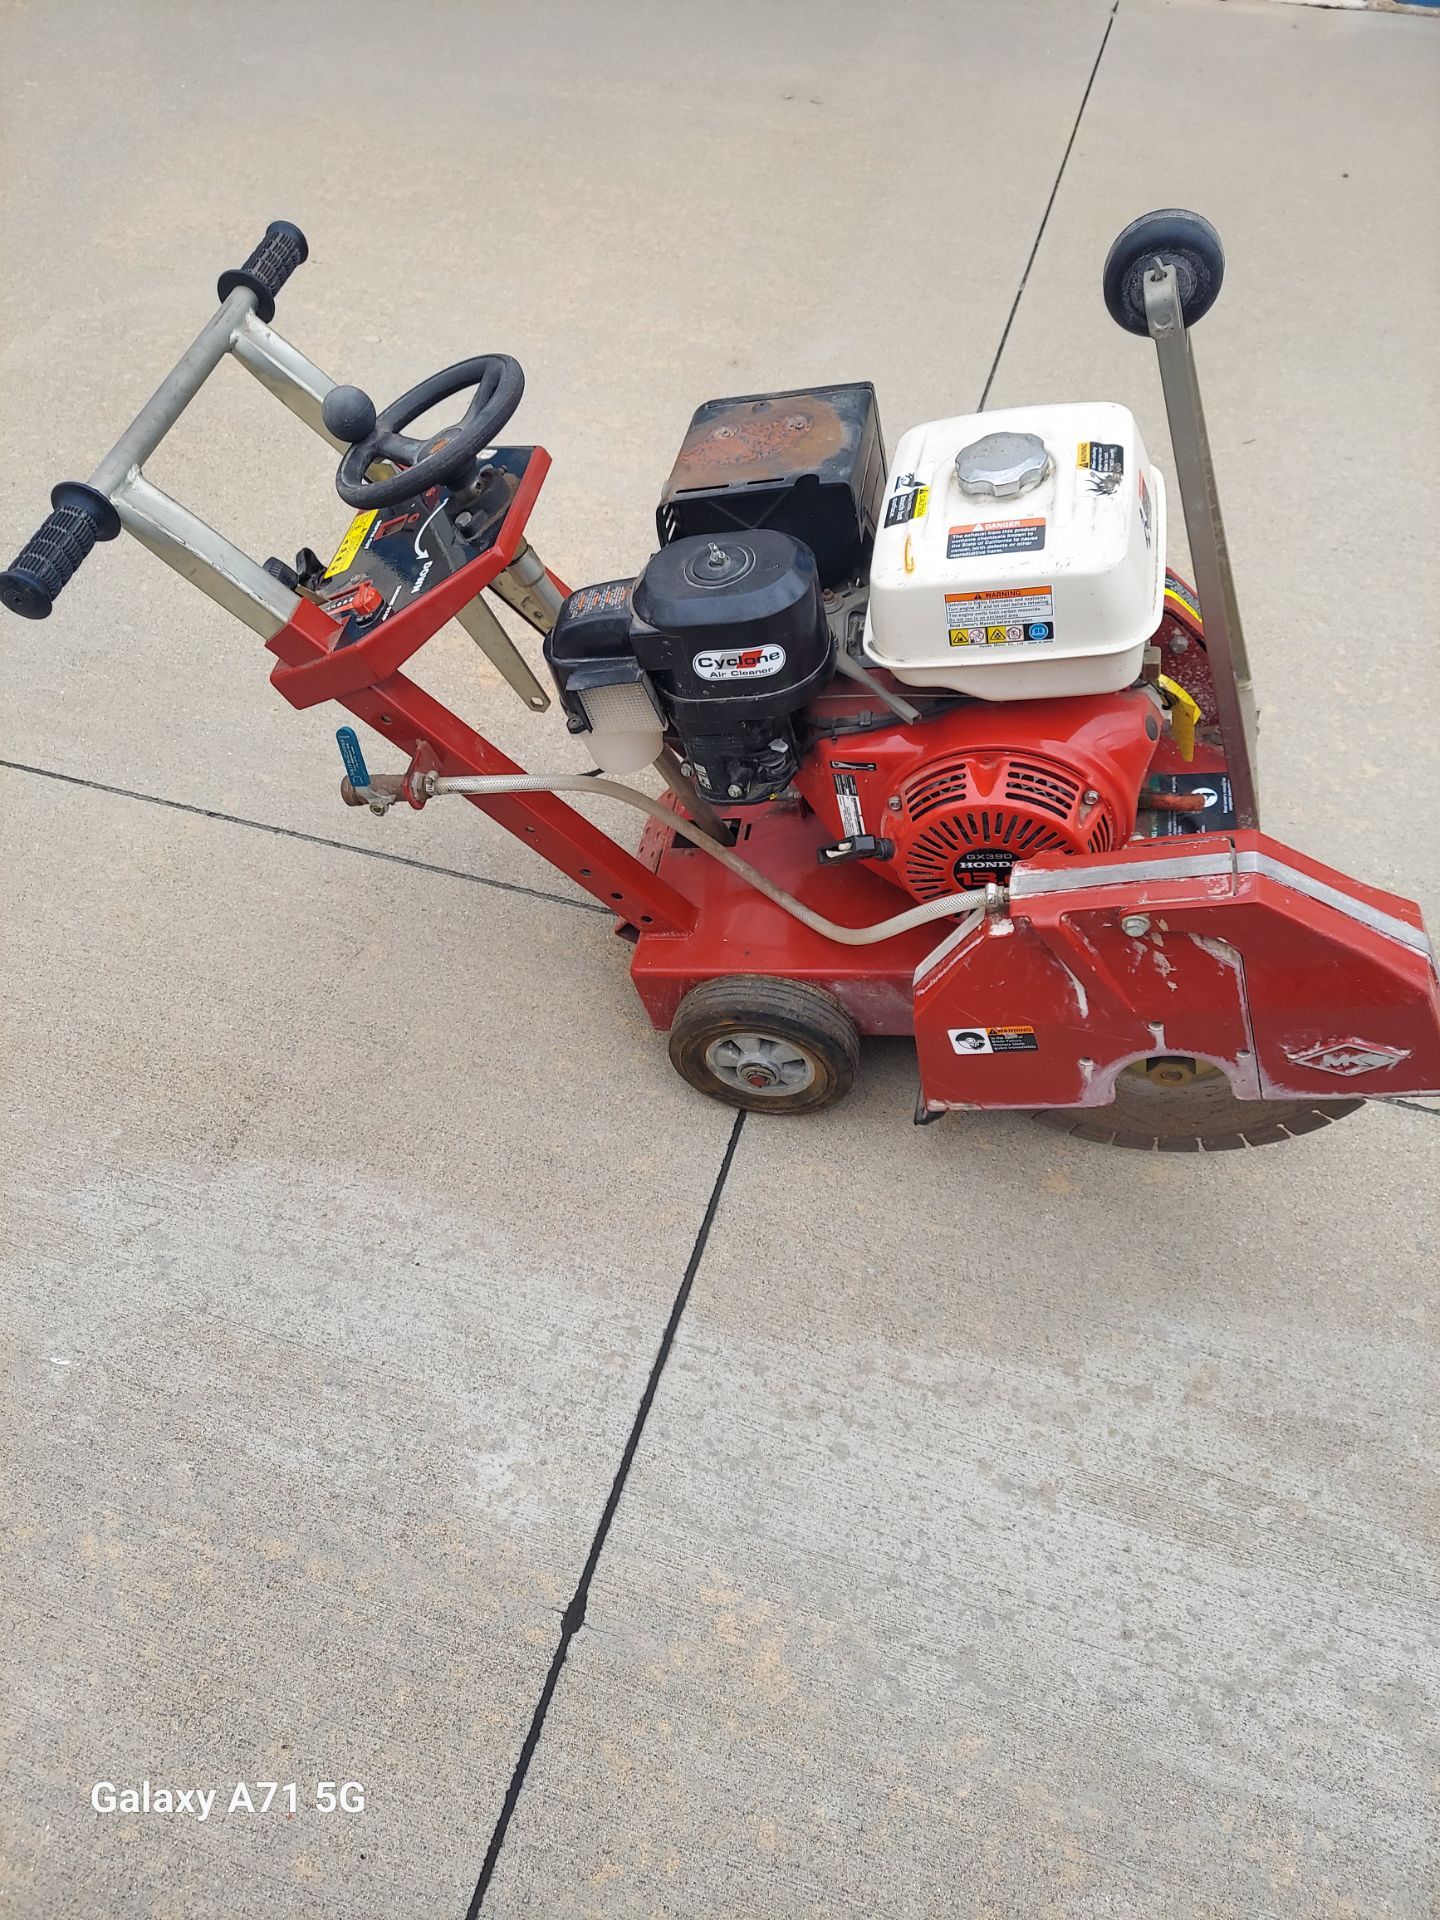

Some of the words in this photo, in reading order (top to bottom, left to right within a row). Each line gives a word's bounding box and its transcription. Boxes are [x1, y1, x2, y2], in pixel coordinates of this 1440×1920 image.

[985, 521, 1020, 529] DANGER
[411, 560, 433, 593] DOWN
[698, 652, 780, 670] Cyclone
[731, 667, 773, 676] Cleaner
